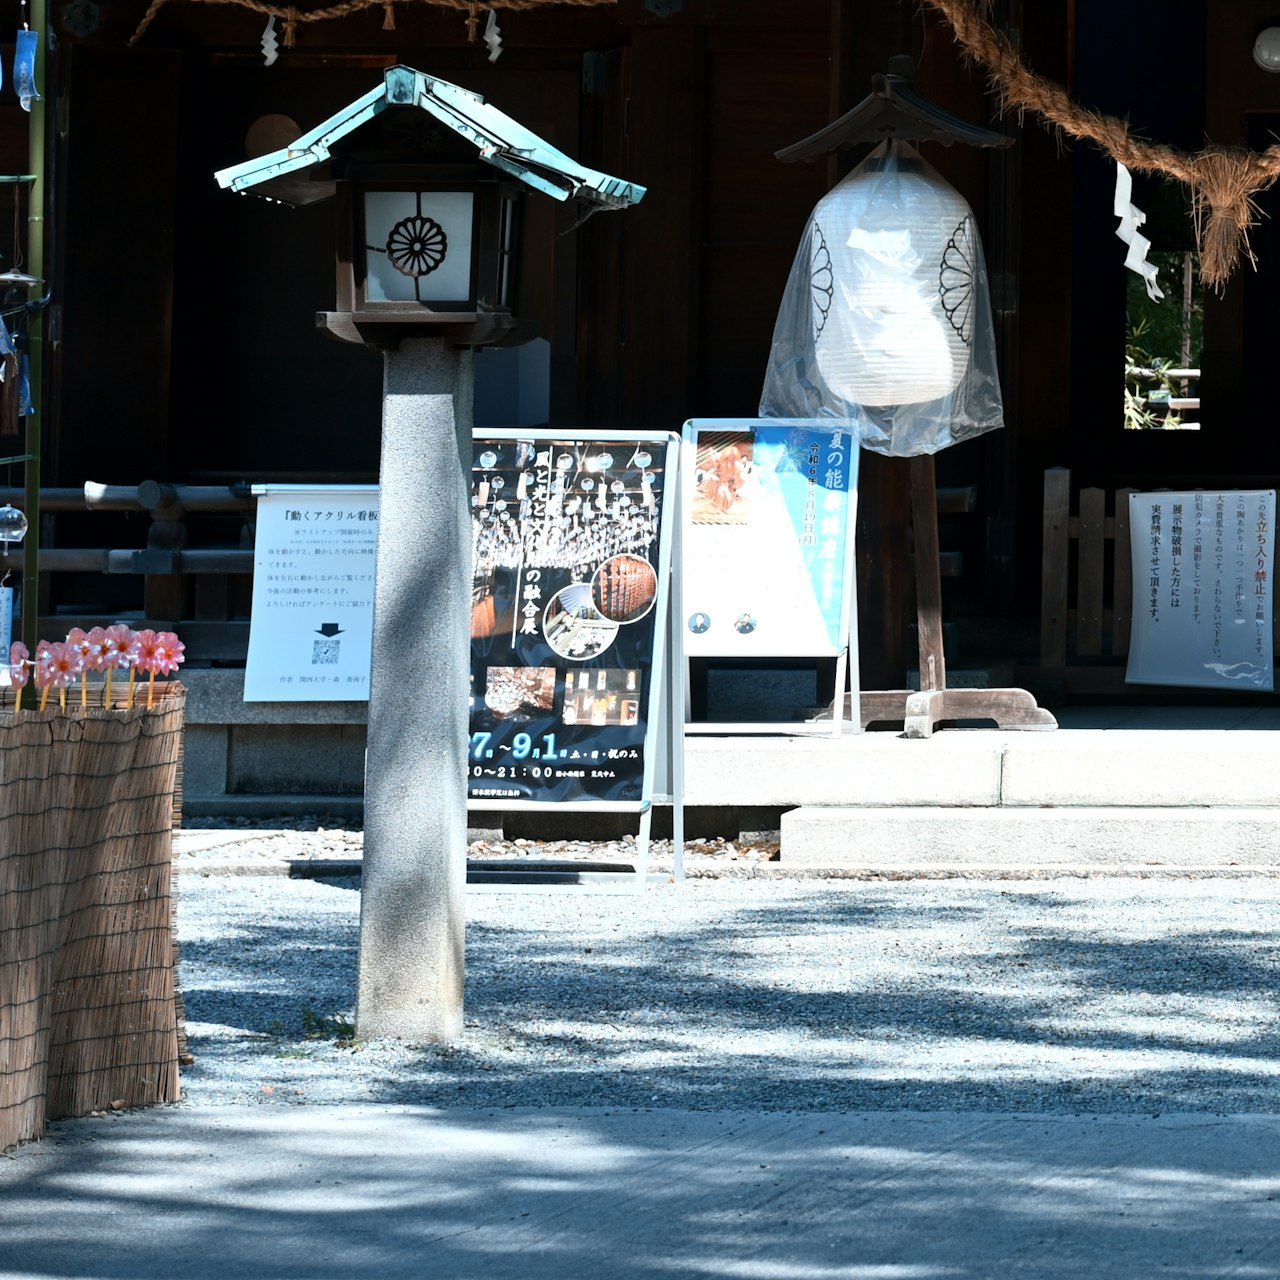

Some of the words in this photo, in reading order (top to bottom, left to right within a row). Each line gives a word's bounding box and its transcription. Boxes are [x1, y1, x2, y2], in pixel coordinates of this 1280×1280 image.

[1149, 504, 1162, 623] 実費請求させて頂きます。
[1171, 504, 1183, 608] 展示物破損した方には
